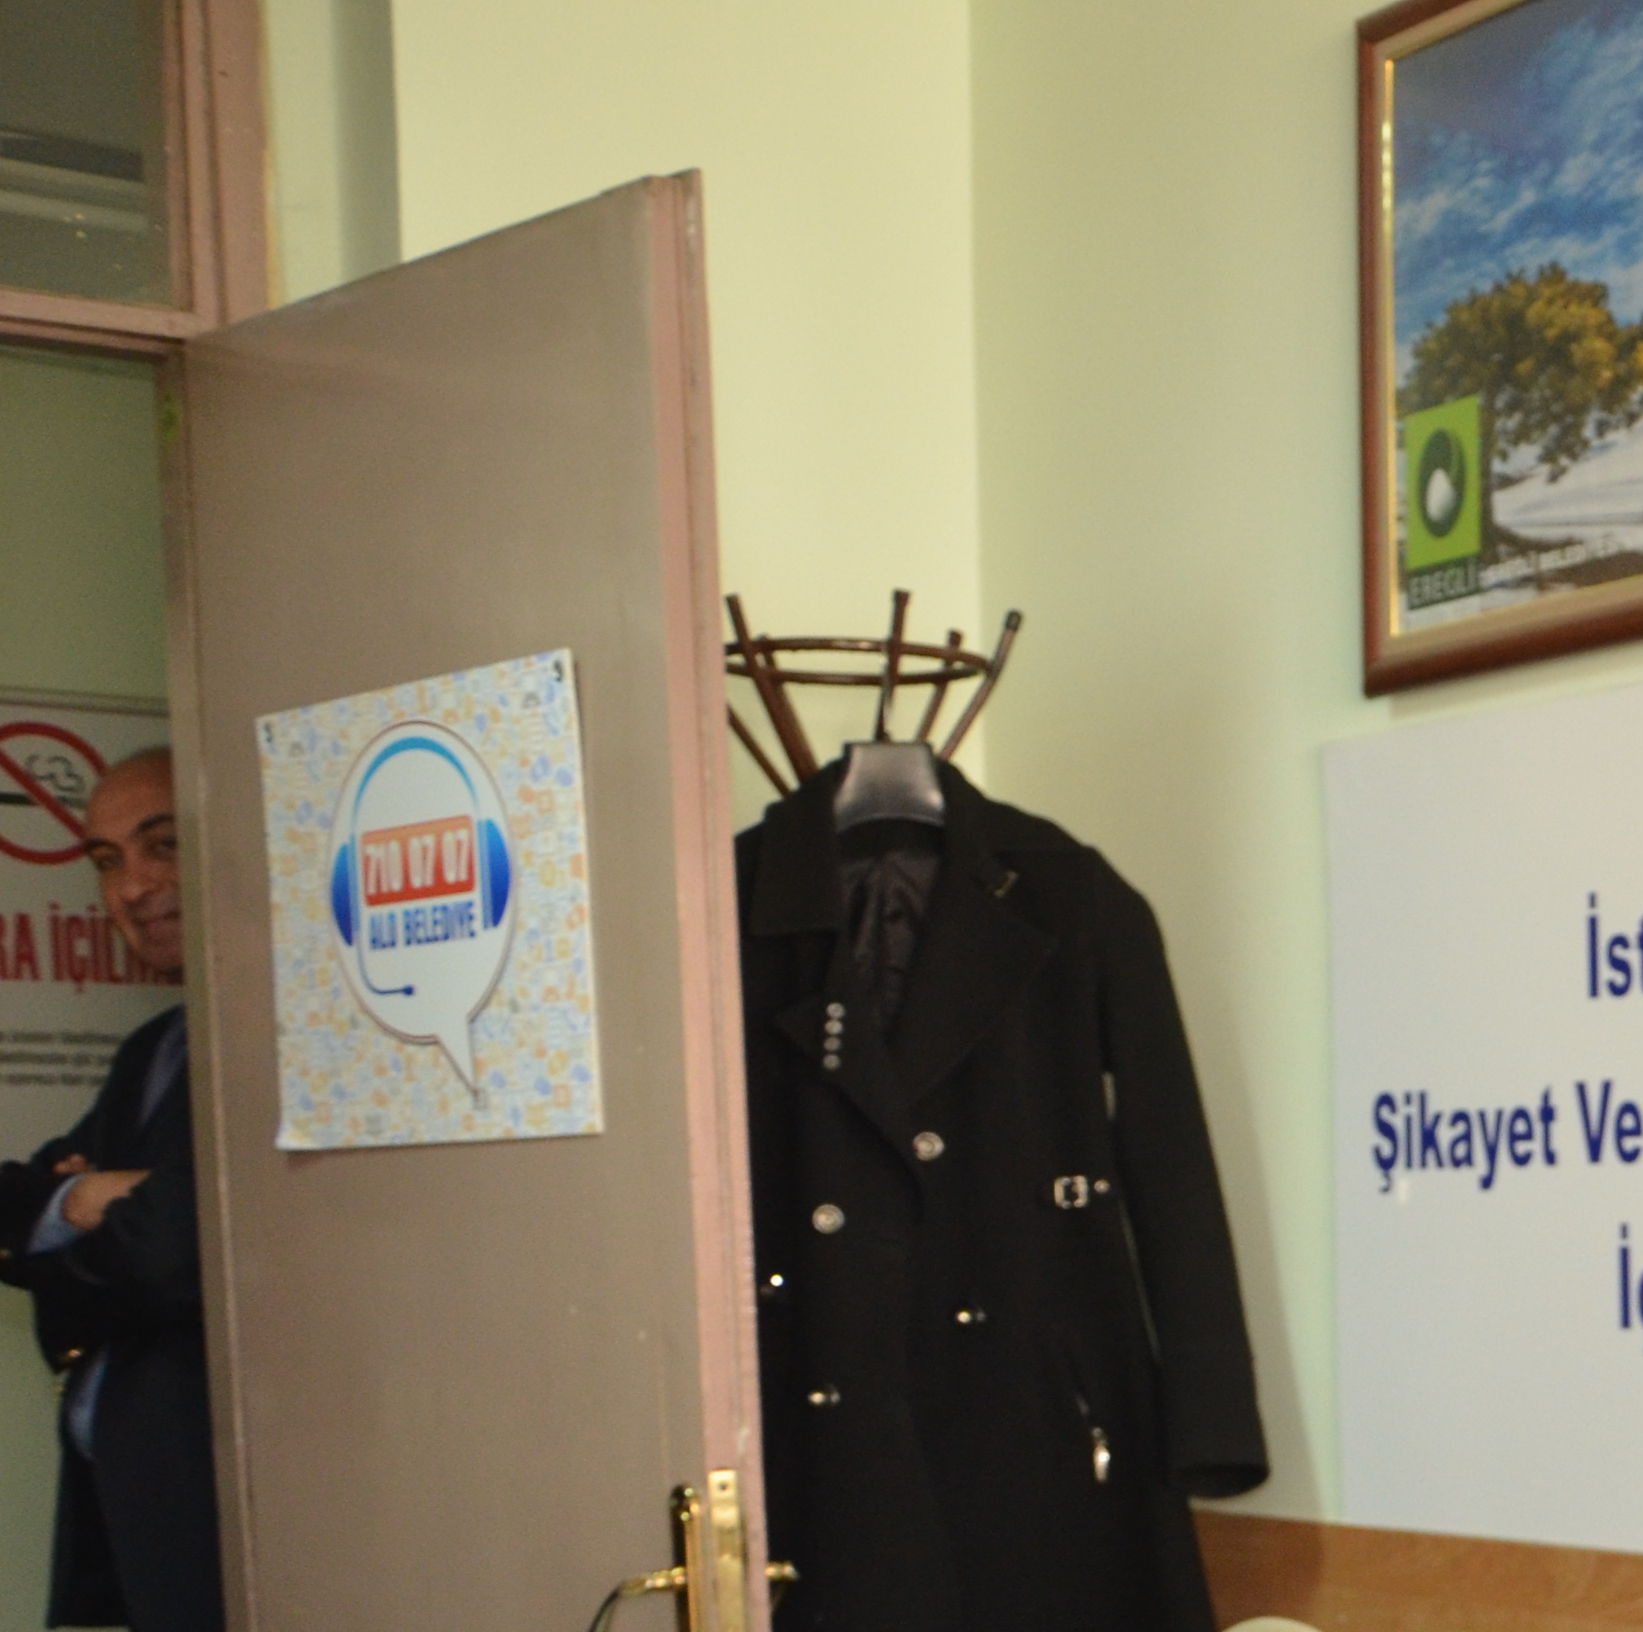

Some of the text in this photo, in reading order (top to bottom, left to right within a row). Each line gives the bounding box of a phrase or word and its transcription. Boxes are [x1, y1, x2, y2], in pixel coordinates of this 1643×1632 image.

[365, 827, 470, 895] 710 07 07
[1373, 1086, 1557, 1193] Şikayet
[1576, 1080, 1643, 1163] Ve
